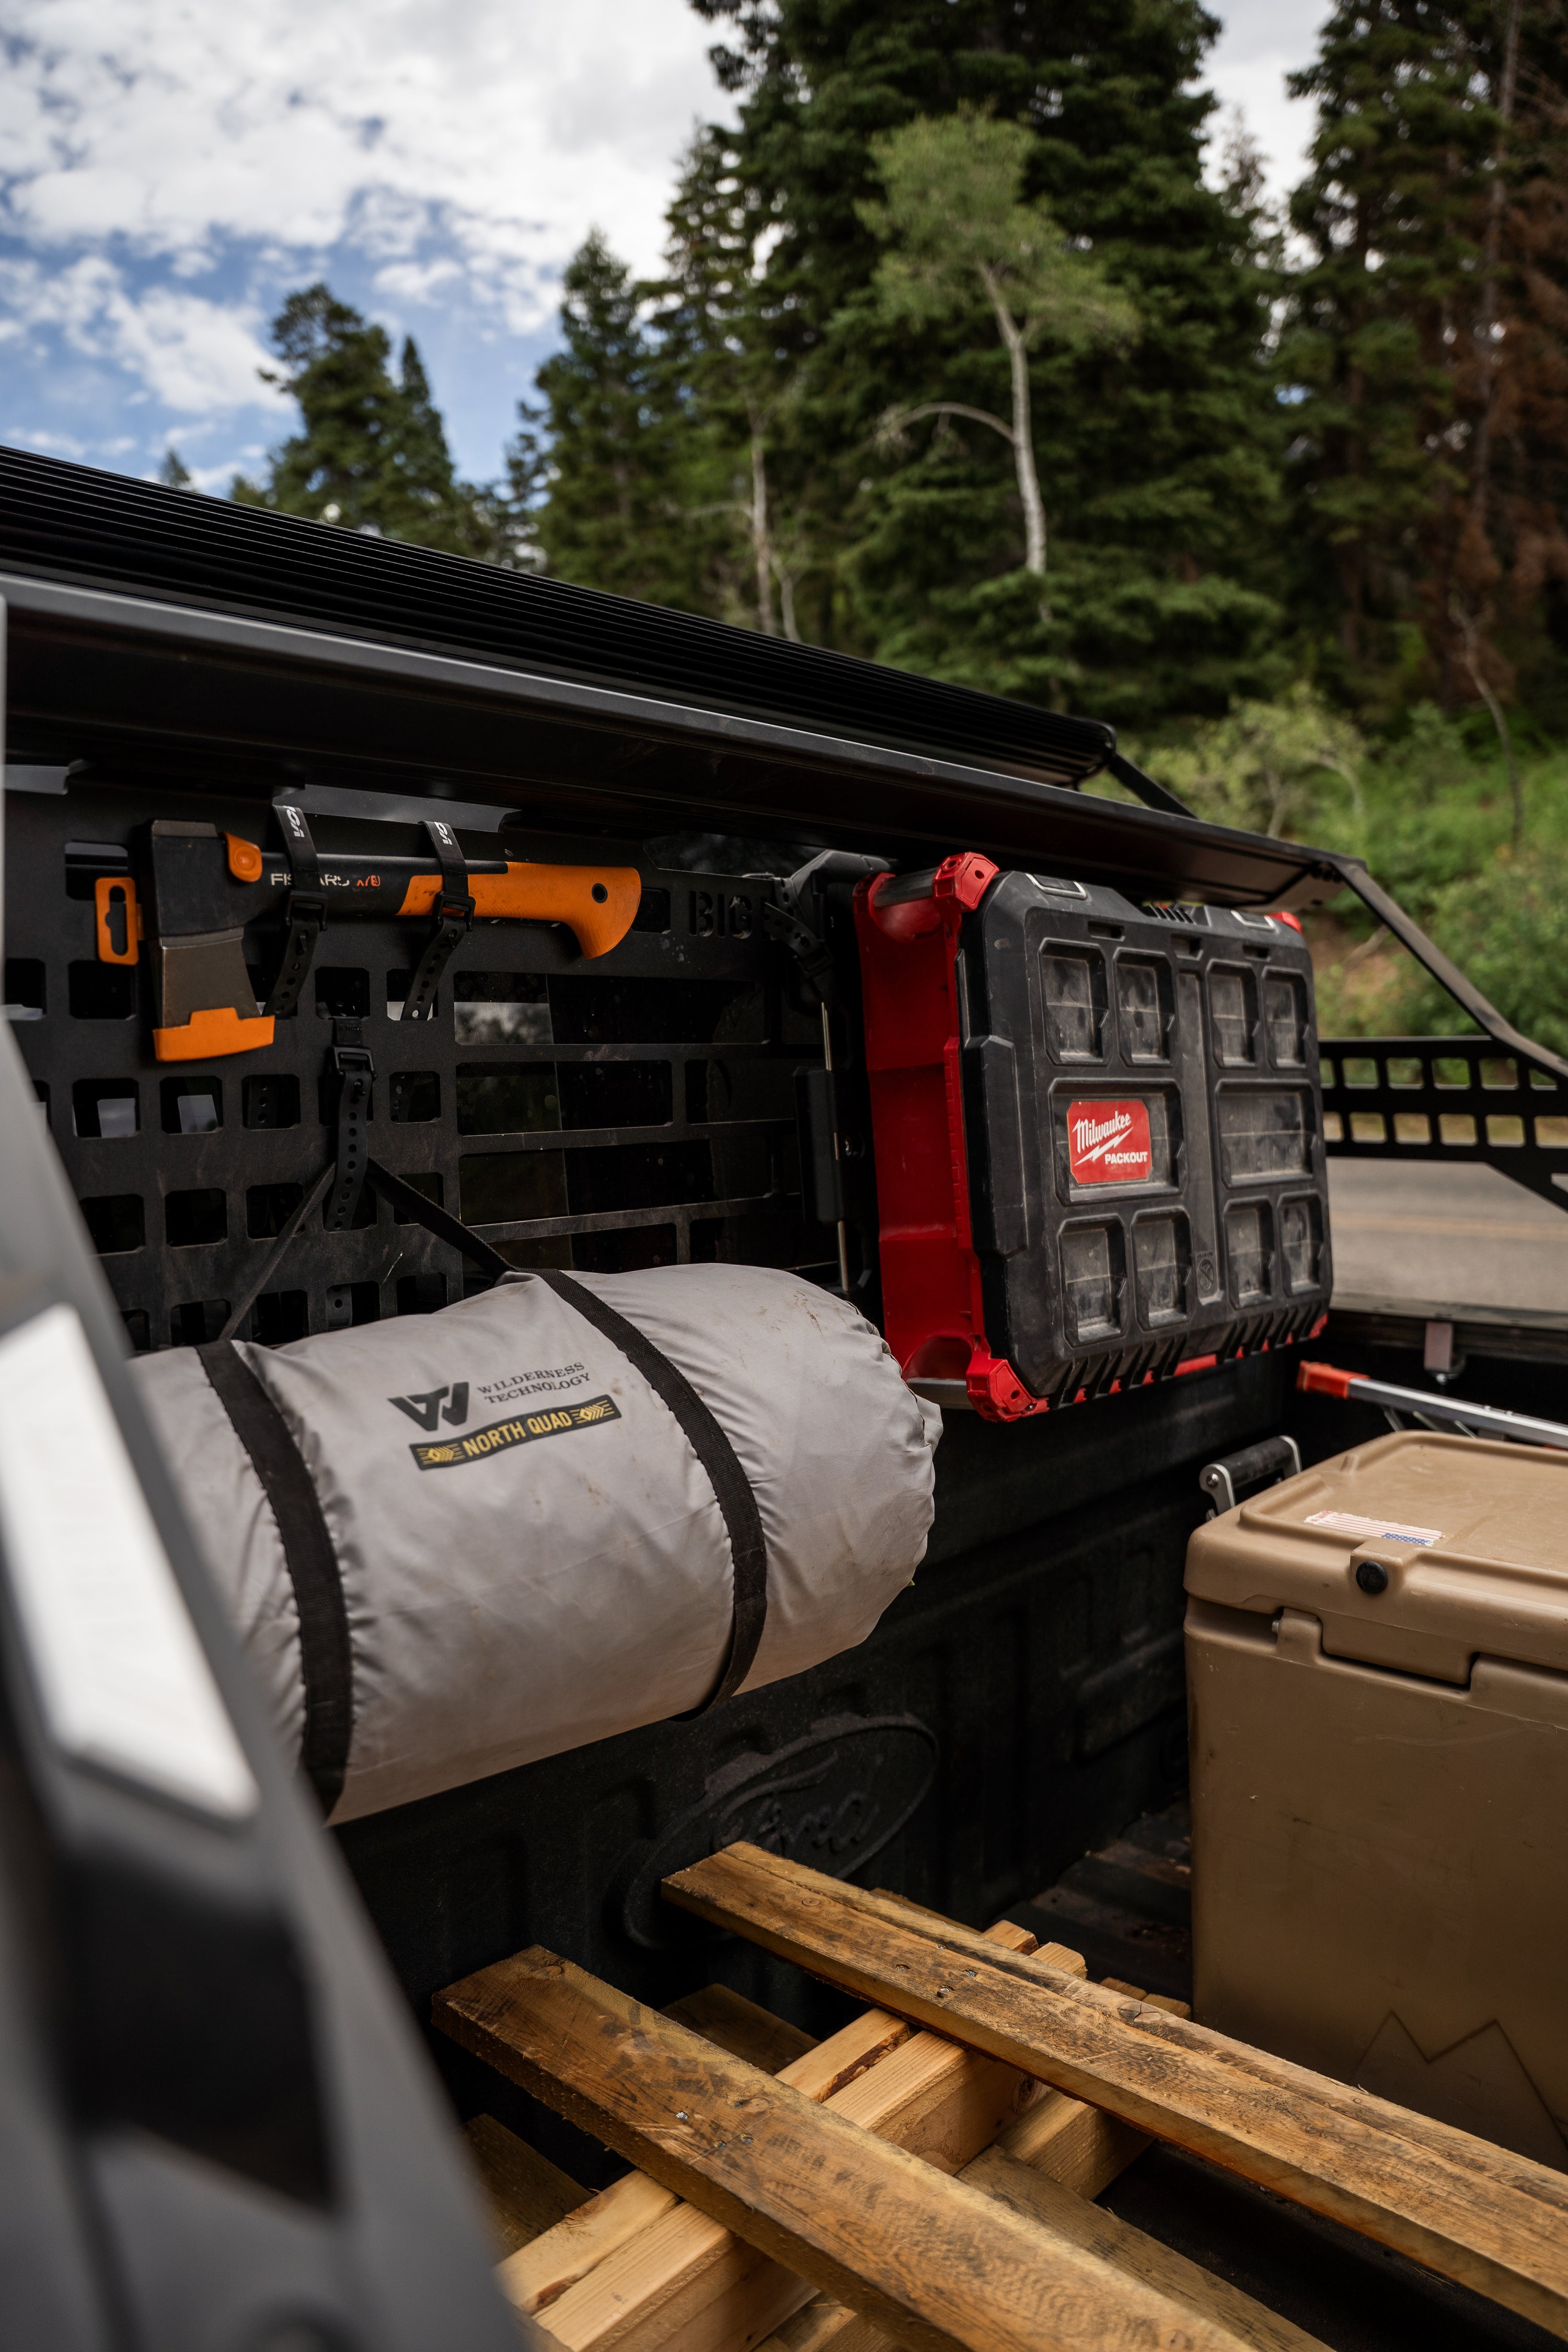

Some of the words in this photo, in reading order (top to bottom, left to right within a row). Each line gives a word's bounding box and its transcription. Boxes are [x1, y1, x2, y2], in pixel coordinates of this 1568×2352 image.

[688, 890, 753, 940] BIG
[1071, 1110, 1132, 1154] Milwaukee
[1104, 1151, 1148, 1165] PACKOUT
[476, 1362, 585, 1394] WILDERNESS
[484, 1373, 591, 1404] TECHNOLOGY
[462, 1422, 526, 1457] NORTH
[526, 1411, 573, 1434] QUAD
